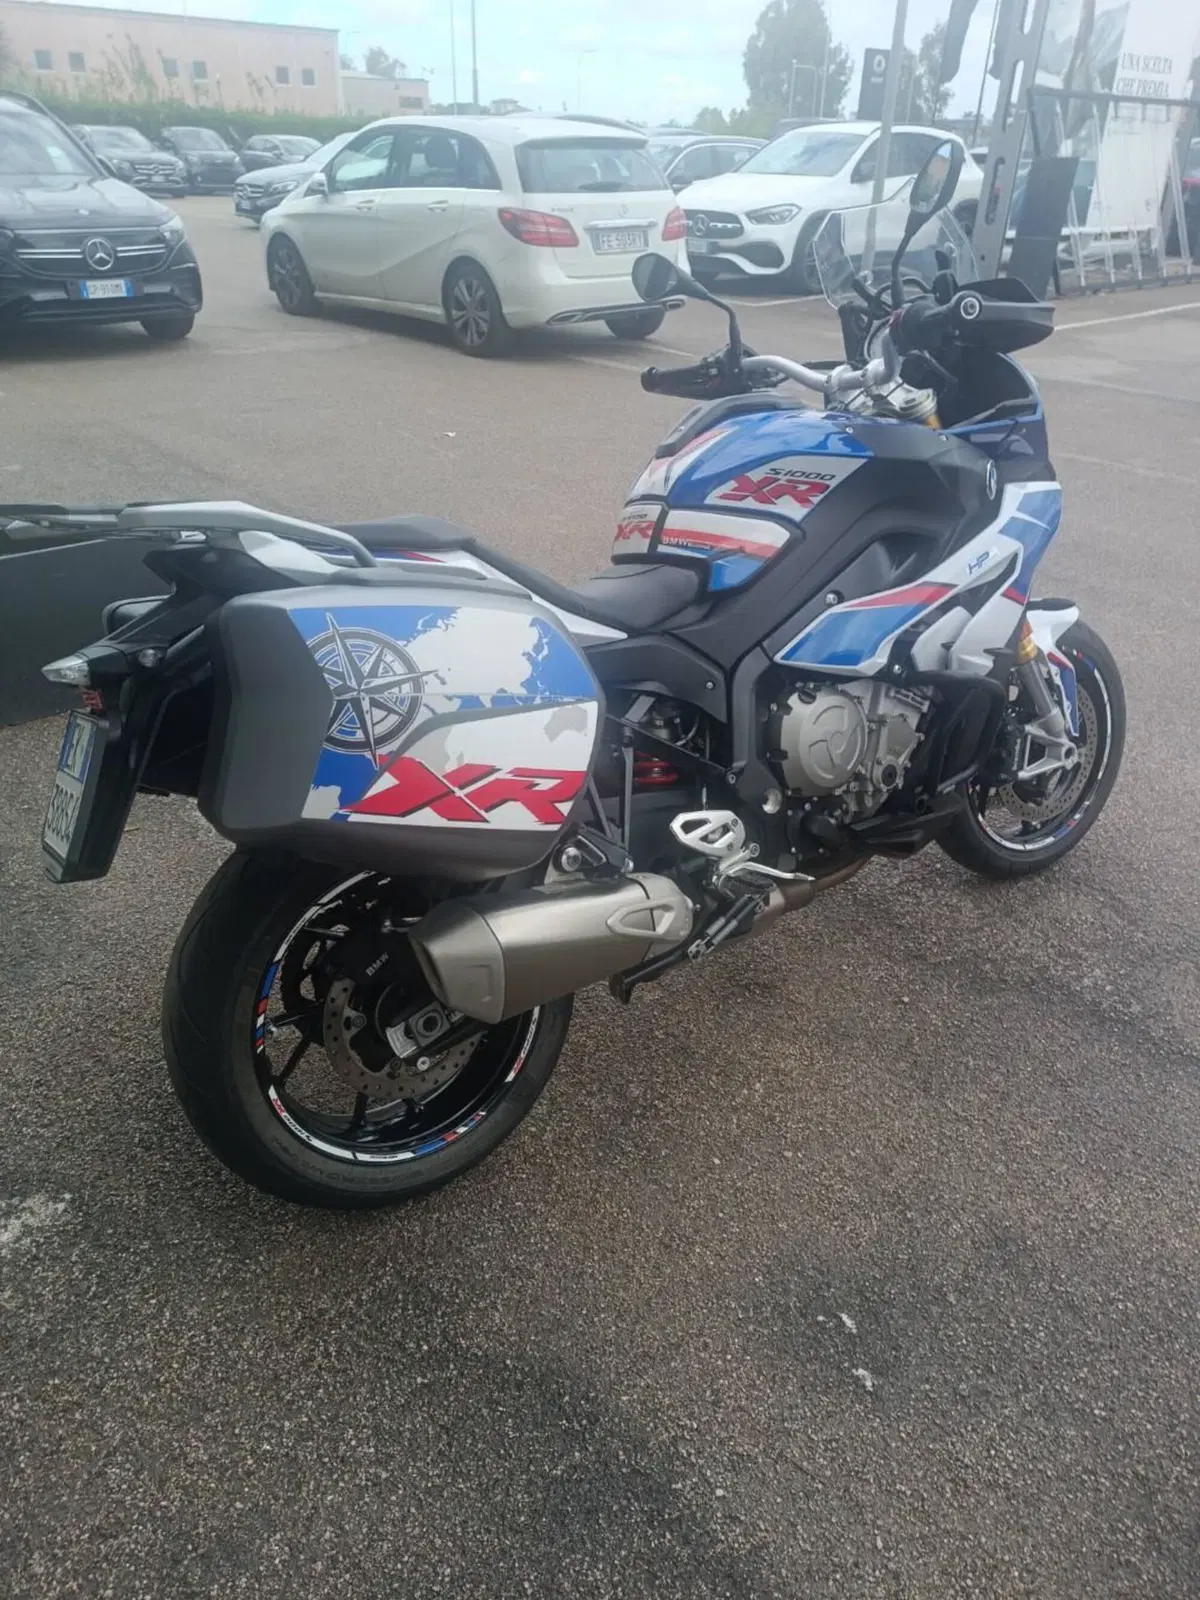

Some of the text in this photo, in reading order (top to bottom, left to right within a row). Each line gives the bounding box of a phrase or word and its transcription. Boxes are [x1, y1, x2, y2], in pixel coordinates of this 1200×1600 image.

[1121, 52, 1173, 74] UNA SCELTA
[1116, 77, 1170, 98] CHE PREMIA
[765, 467, 836, 481] S1000
[715, 474, 831, 508] XR
[662, 536, 690, 547] BMW
[968, 551, 990, 576] HP
[338, 754, 587, 825] XR
[366, 951, 389, 977] BMW
